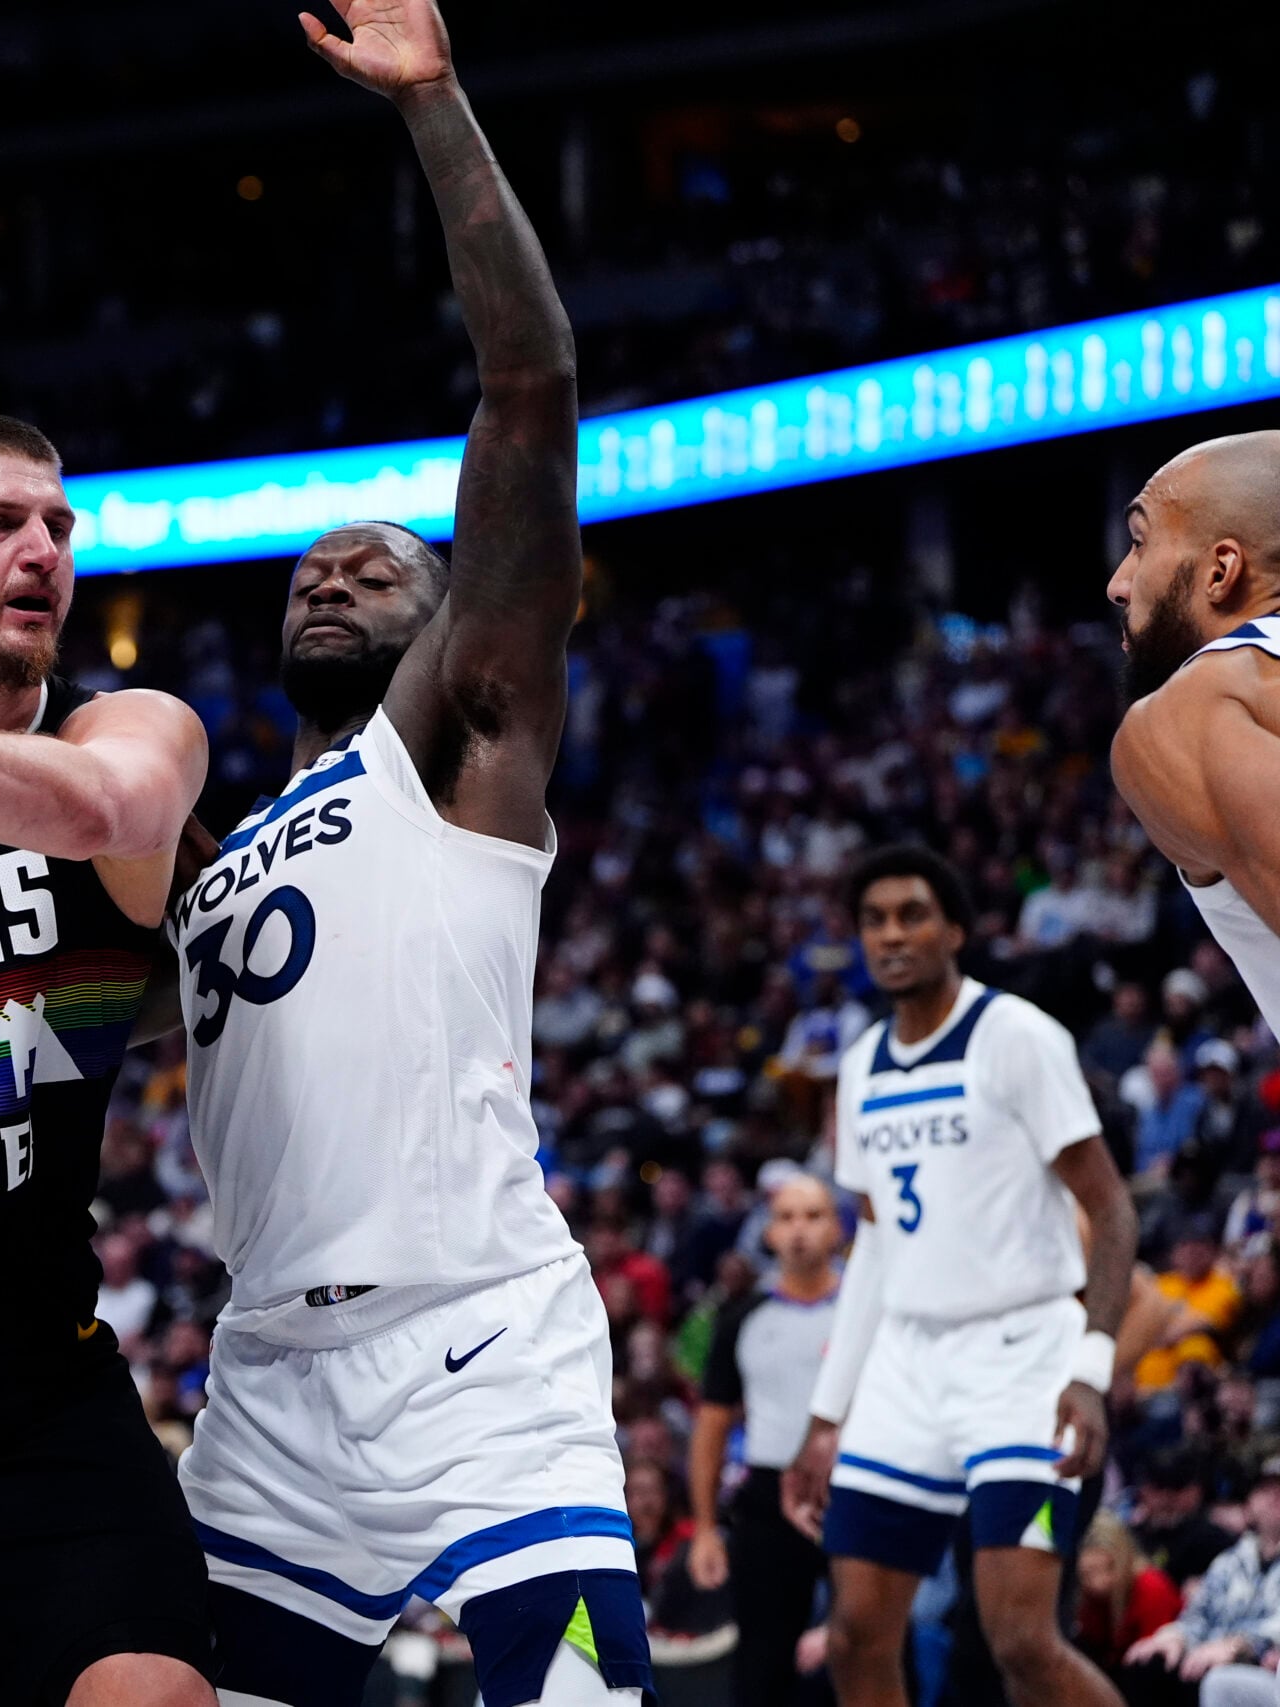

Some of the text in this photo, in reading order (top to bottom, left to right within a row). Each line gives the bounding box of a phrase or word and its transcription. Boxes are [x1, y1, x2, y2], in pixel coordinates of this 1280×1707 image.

[170, 798, 353, 943] WOLVES
[185, 884, 316, 1048] 30
[857, 1114, 968, 1153] WOLVES
[891, 1164, 922, 1233] 3
